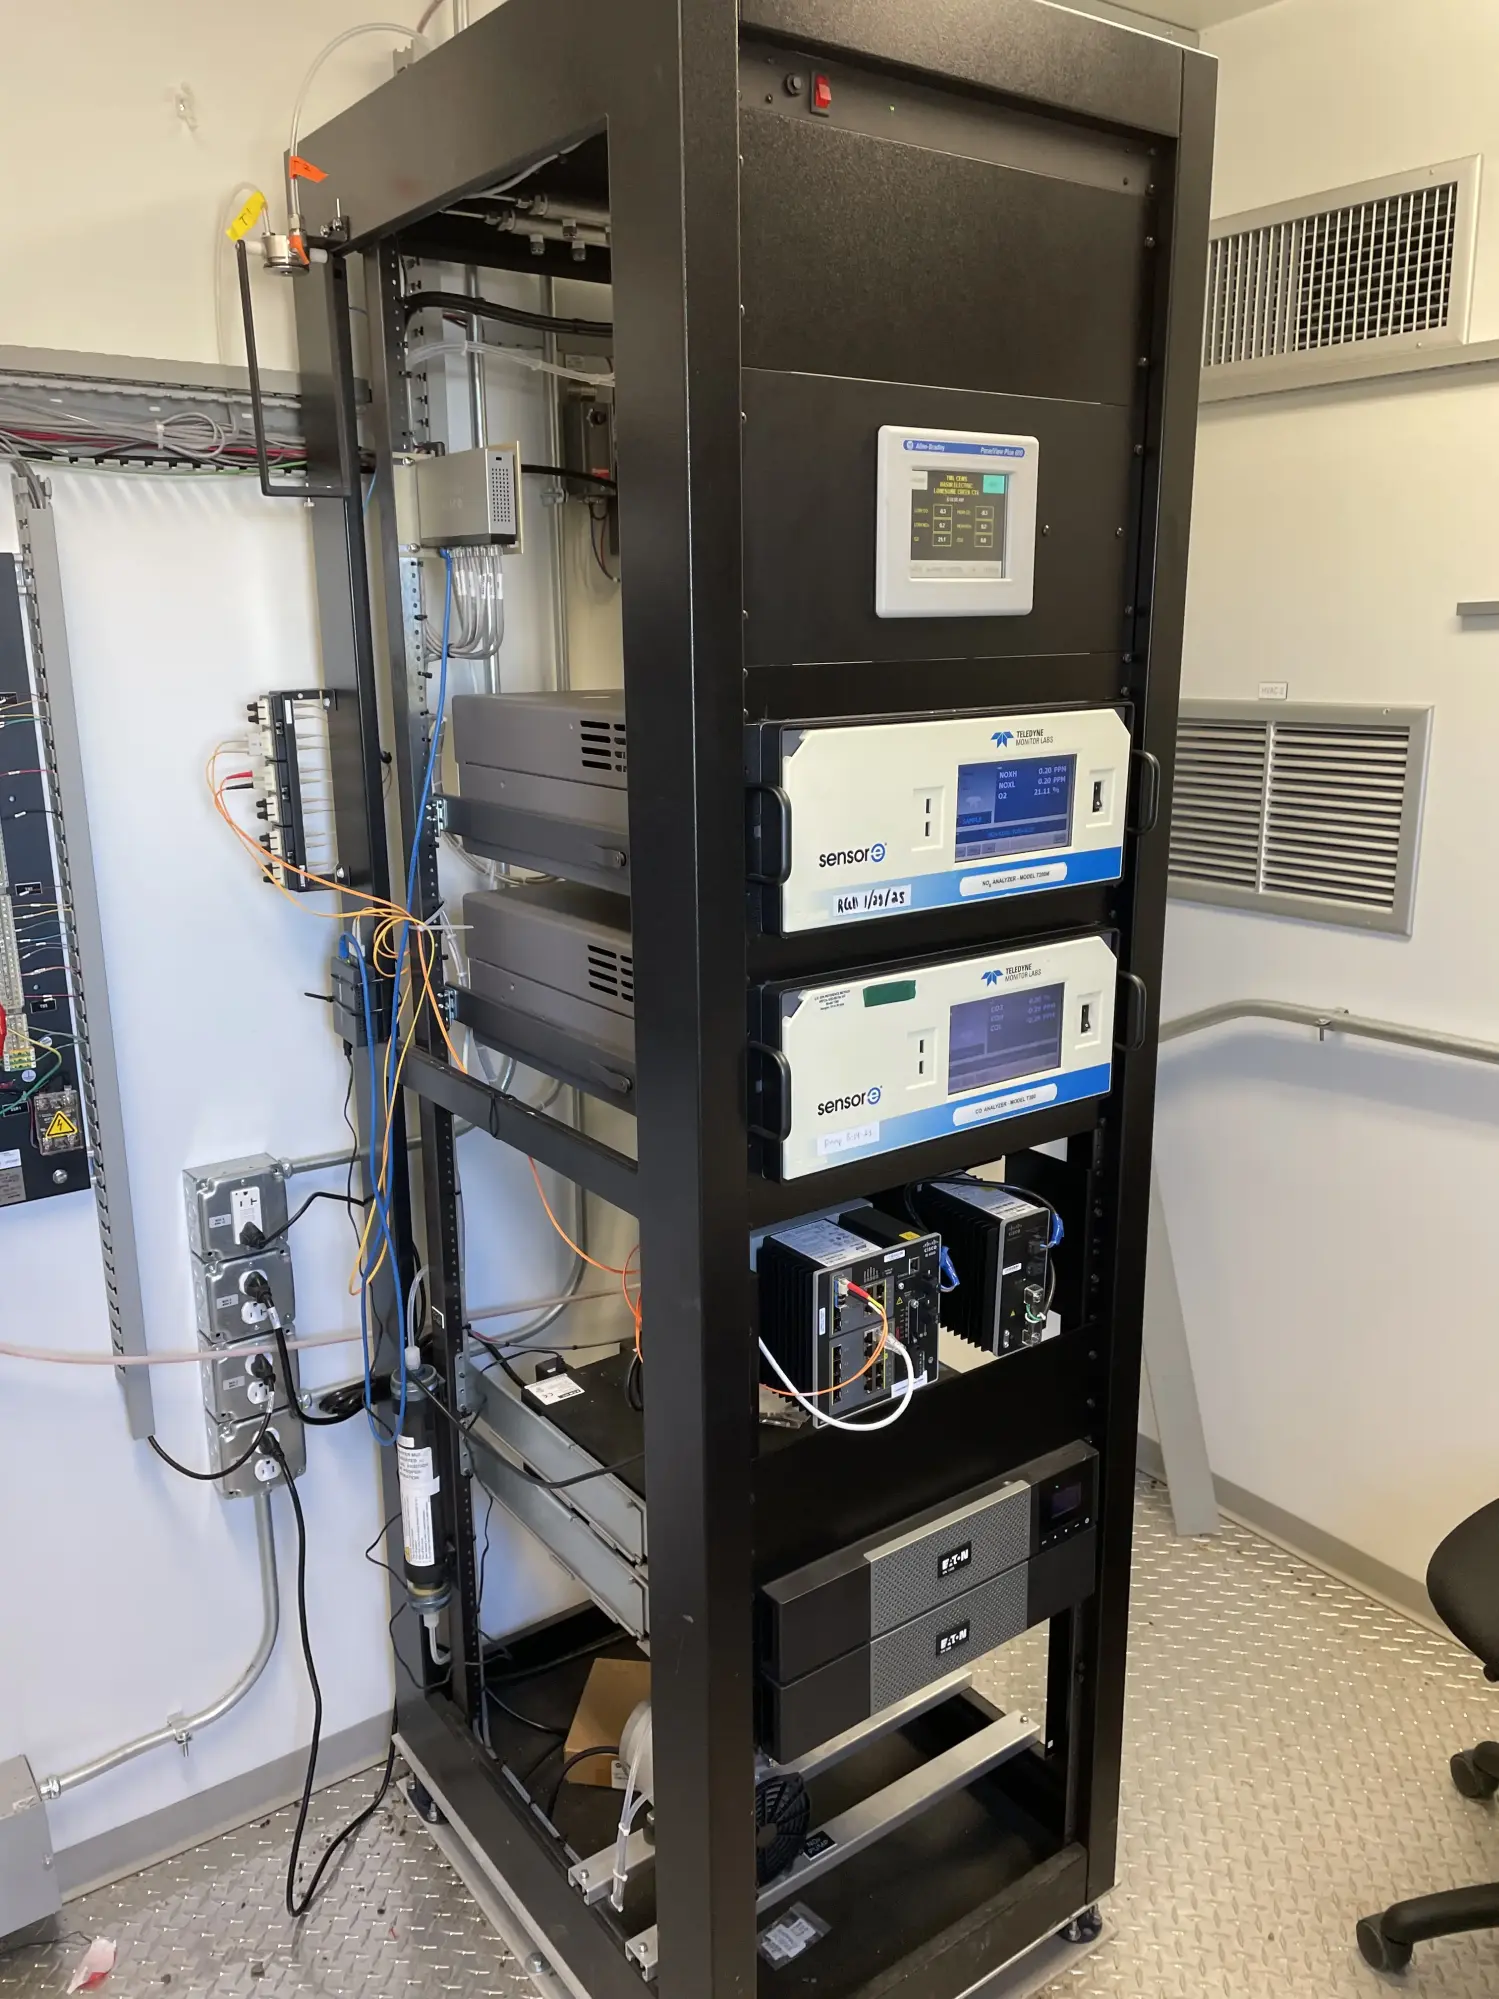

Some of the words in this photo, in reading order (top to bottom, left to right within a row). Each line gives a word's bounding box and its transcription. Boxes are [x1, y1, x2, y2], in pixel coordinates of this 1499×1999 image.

[916, 442, 945, 452] Allen-Bradley
[980, 447, 1003, 455] PanelView
[1017, 729, 1044, 738] TELEDYNE
[1016, 738, 1040, 746] MONITOR
[992, 876, 1016, 884] ANALYZER
[1005, 963, 1033, 974] TELEDYNE
[1005, 972, 1028, 982] MONITOR
[1029, 969, 1041, 978] LABS
[984, 1102, 1007, 1112] ANALYZER
[1010, 1097, 1025, 1105] MODEL
[924, 1245, 937, 1253] cisco
